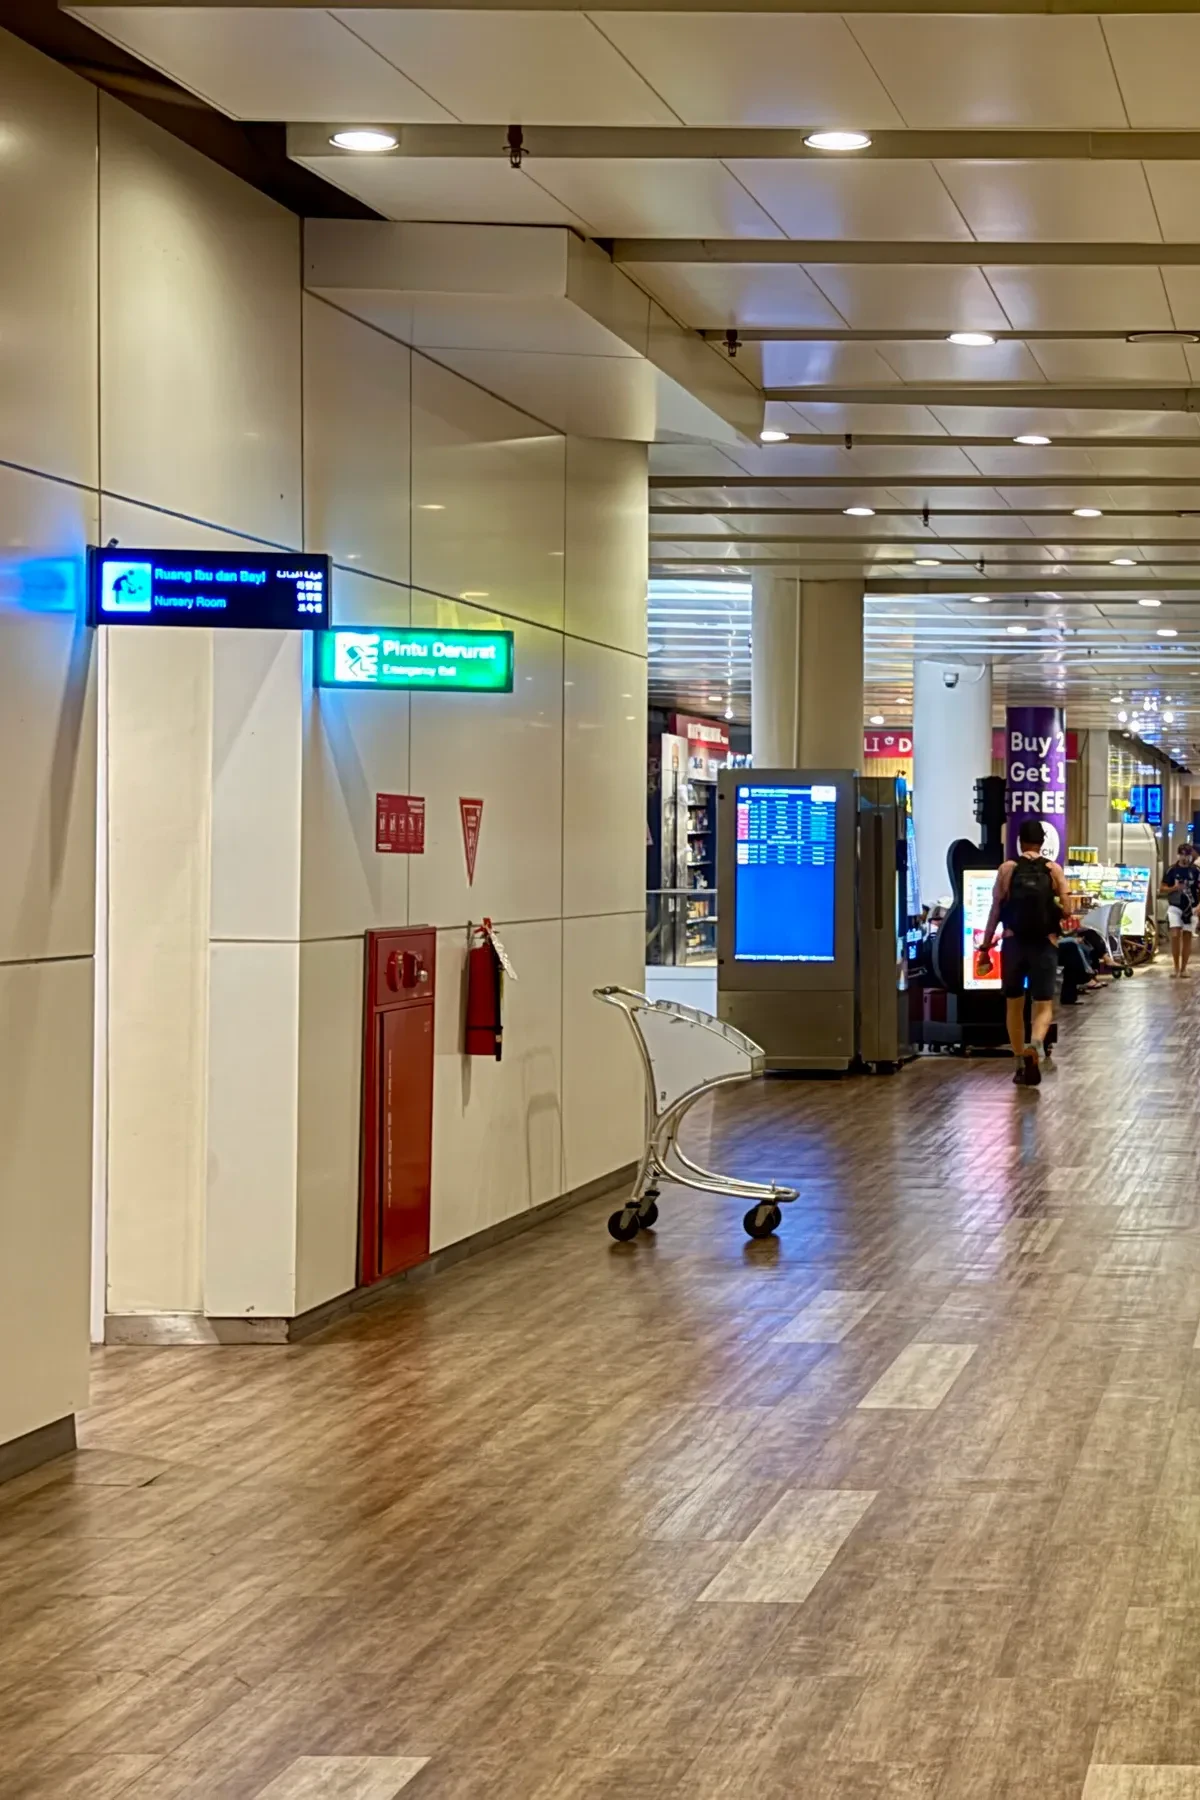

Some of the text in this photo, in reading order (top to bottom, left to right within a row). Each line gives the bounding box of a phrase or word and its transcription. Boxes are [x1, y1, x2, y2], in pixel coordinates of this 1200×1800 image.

[154, 568, 192, 583] Ruang
[194, 569, 212, 581] Ibu
[216, 569, 237, 582] dan
[240, 570, 266, 584] Bayi
[154, 596, 226, 609] Nursery Room
[383, 640, 496, 659] Pintu Darurat
[1011, 732, 1065, 758] Buy 2
[1010, 762, 1066, 784] Get 1
[1012, 791, 1065, 814] FREE
